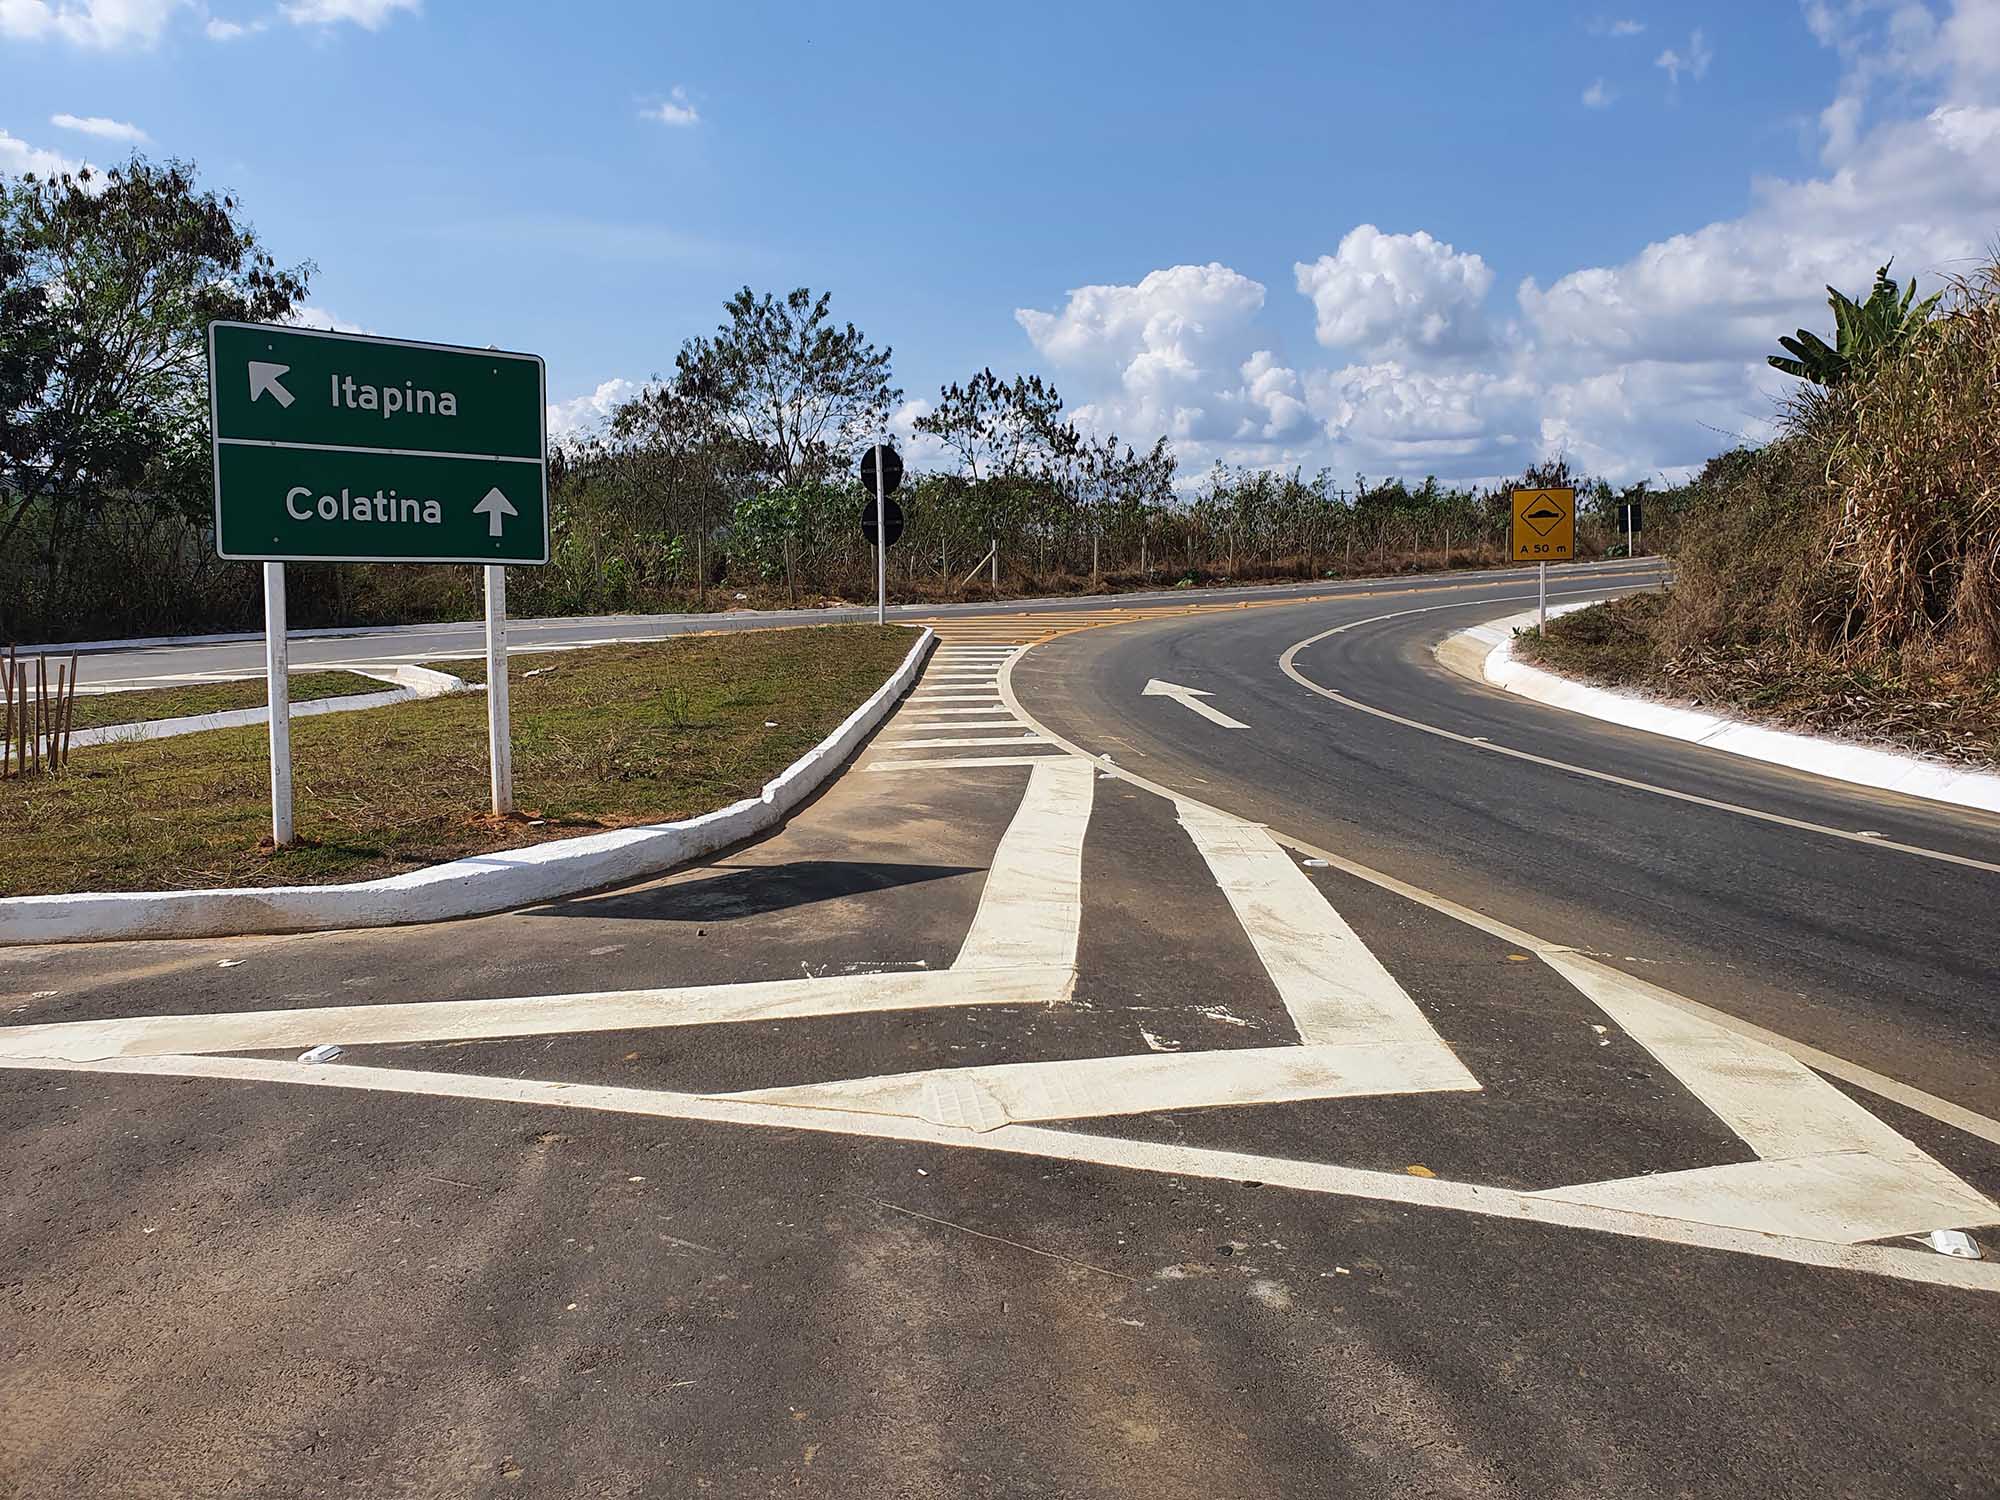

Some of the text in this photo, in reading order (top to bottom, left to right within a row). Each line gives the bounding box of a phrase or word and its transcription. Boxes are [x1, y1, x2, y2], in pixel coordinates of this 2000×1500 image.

[330, 374, 458, 418] Itapina
[286, 486, 442, 524] Colatina
[1520, 544, 1566, 553] A 50 m
